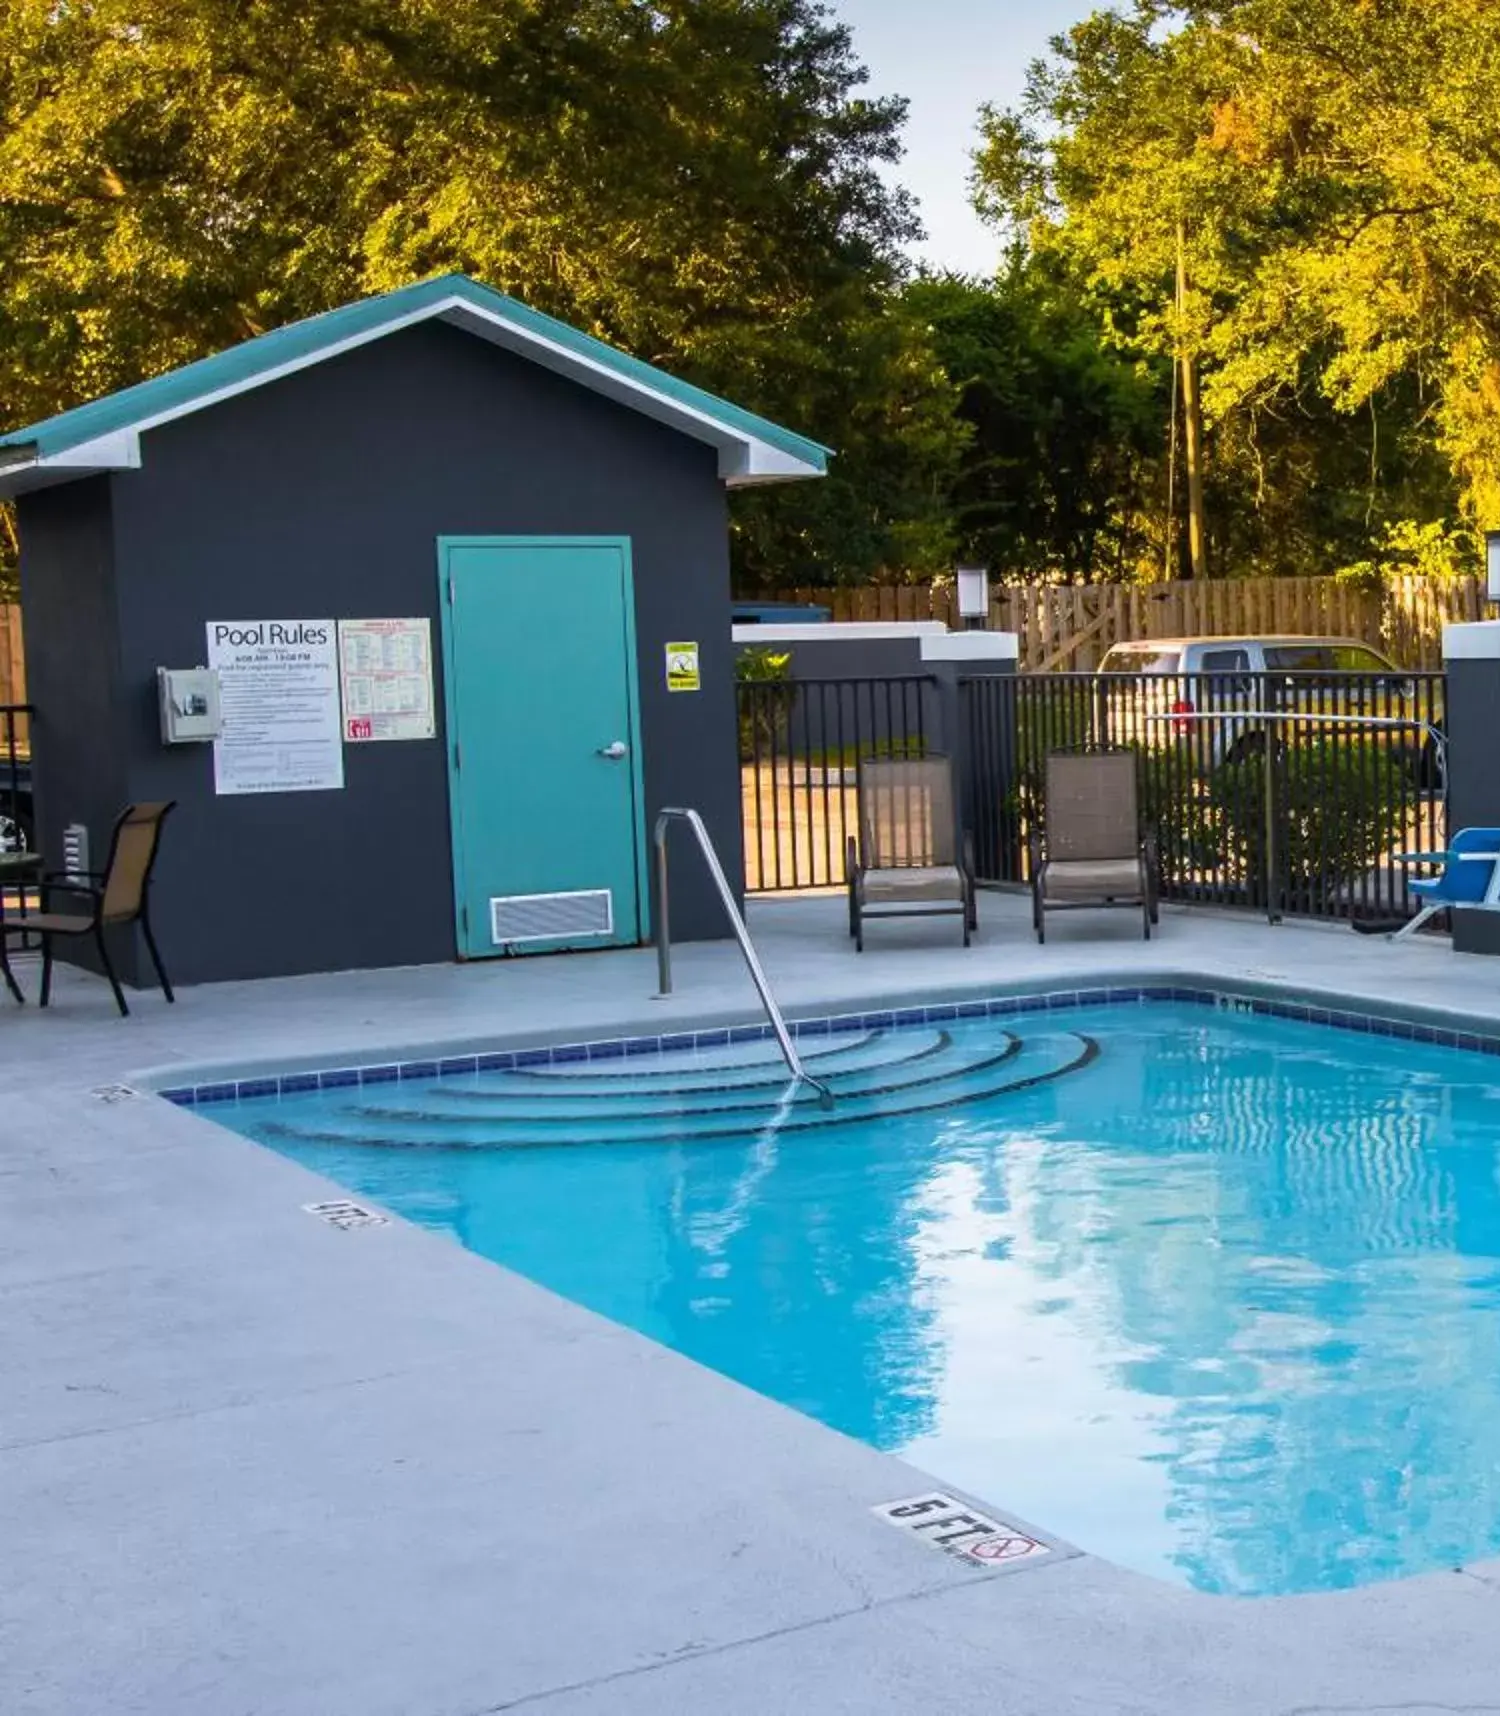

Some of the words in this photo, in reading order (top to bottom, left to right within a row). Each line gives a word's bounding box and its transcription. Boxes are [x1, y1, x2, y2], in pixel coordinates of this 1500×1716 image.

[215, 624, 264, 646] Pool
[269, 623, 328, 645] Rules
[889, 1498, 950, 1517] 5
[912, 1514, 996, 1544] FT
